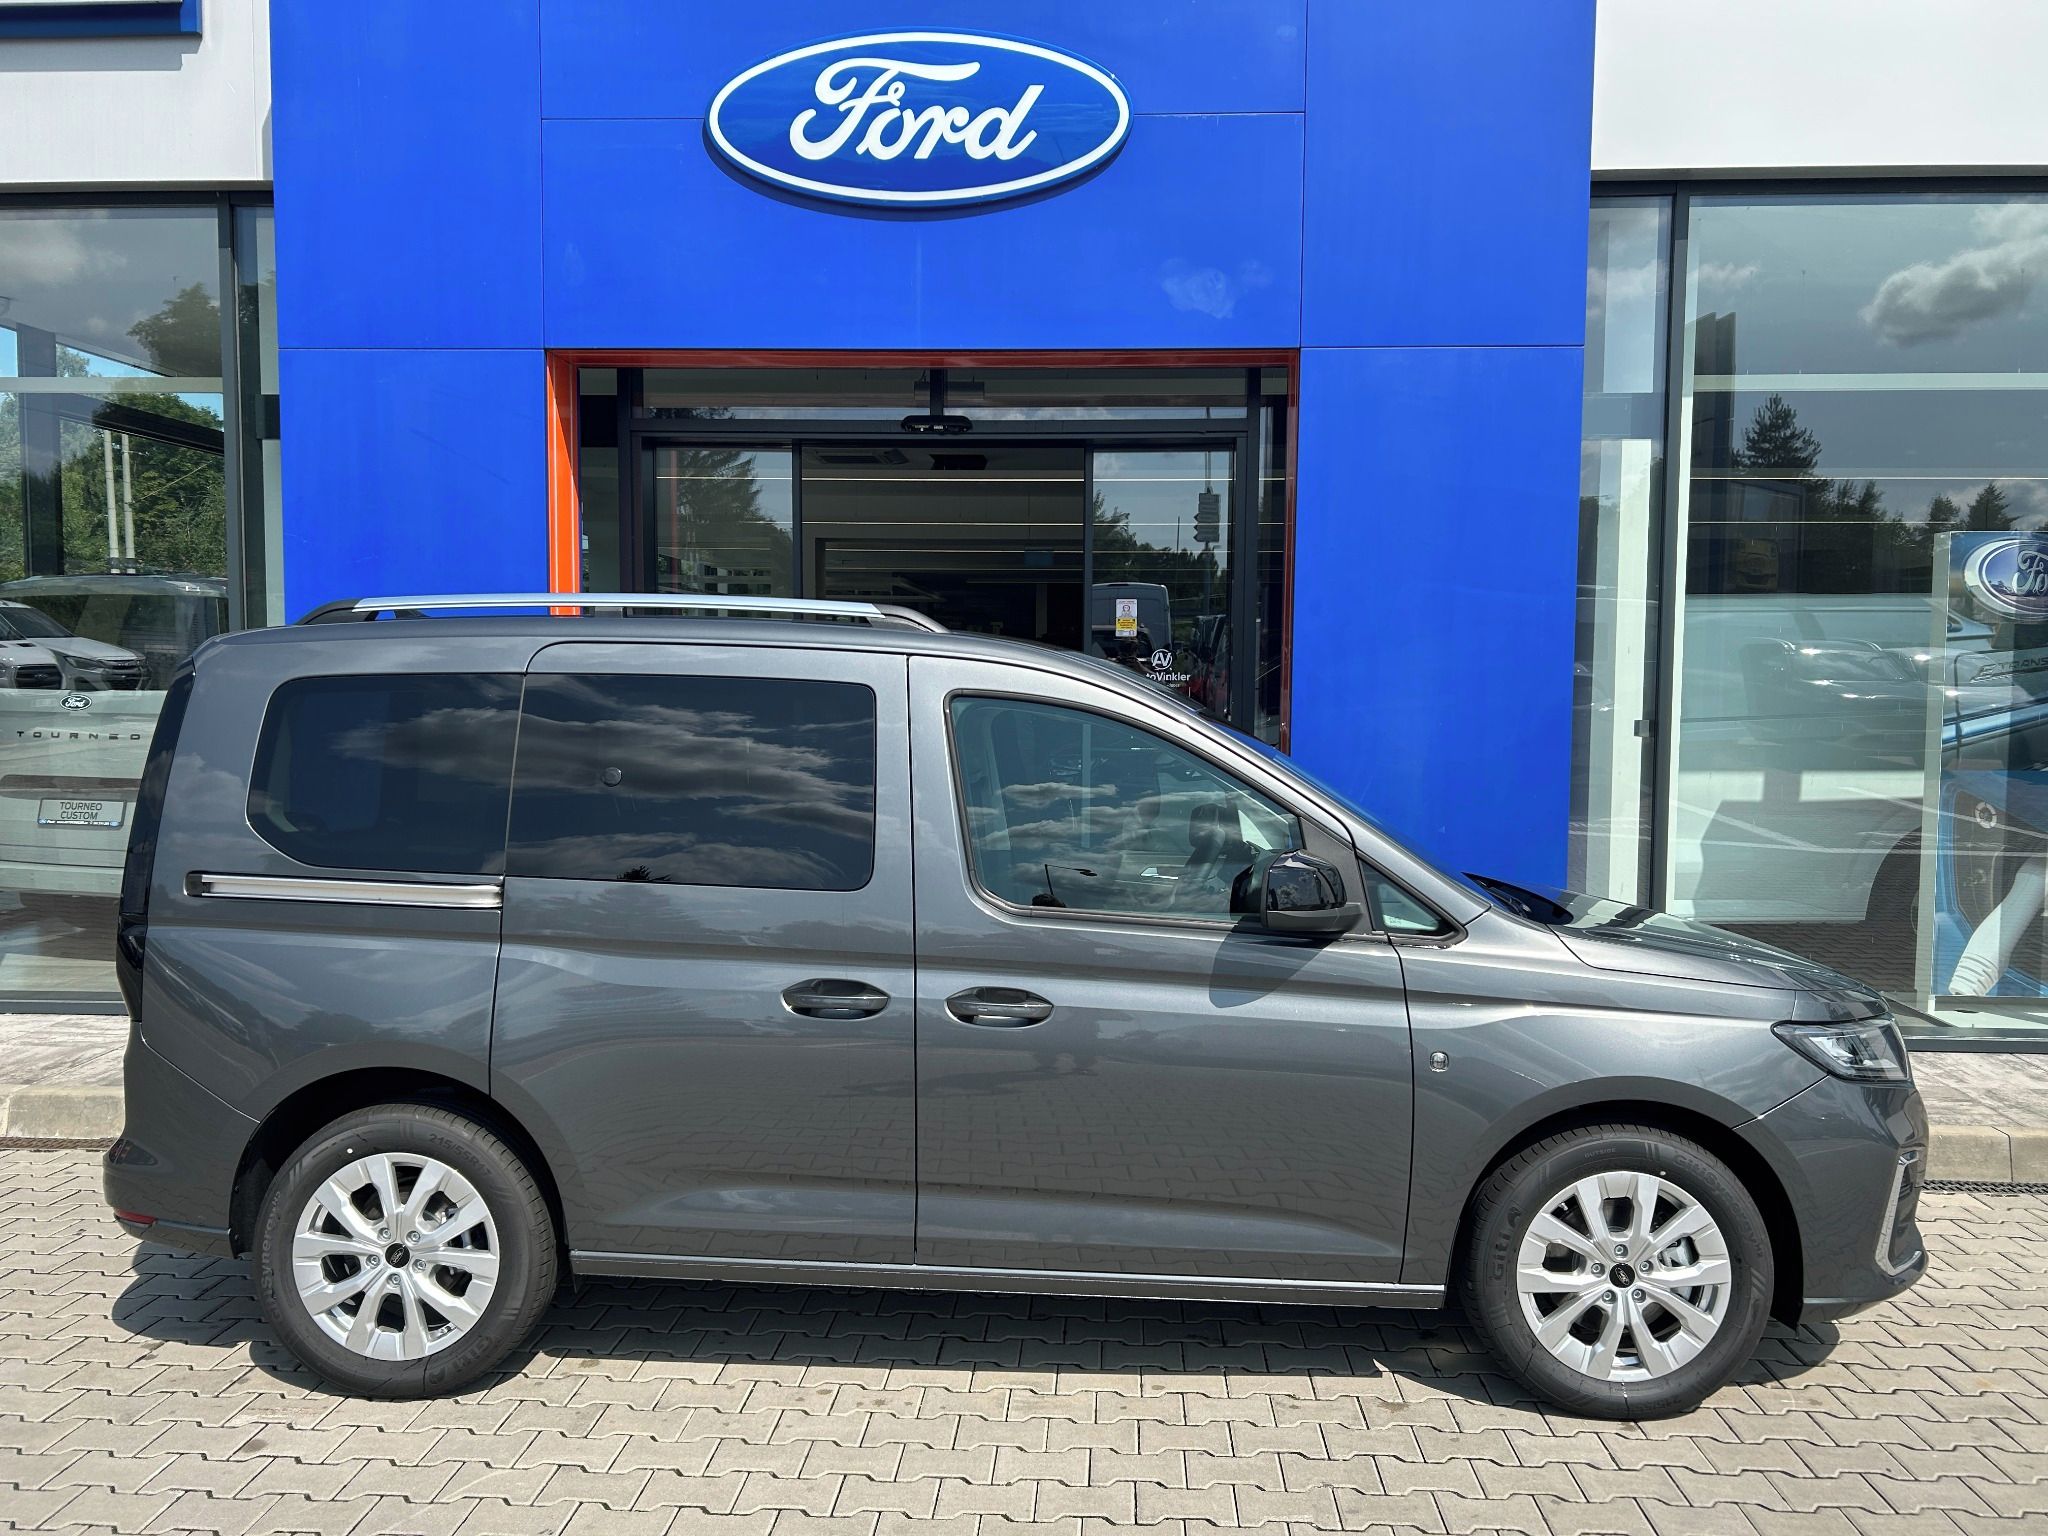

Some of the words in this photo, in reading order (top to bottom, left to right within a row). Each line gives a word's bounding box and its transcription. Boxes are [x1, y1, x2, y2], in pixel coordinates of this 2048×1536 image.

[789, 57, 1045, 161] Ford
[2012, 550, 2048, 595] Fo
[65, 697, 85, 708] Ford
[17, 730, 141, 740] TOURNEO
[60, 801, 103, 811] TOURNEO
[60, 811, 99, 820] CUSTOM
